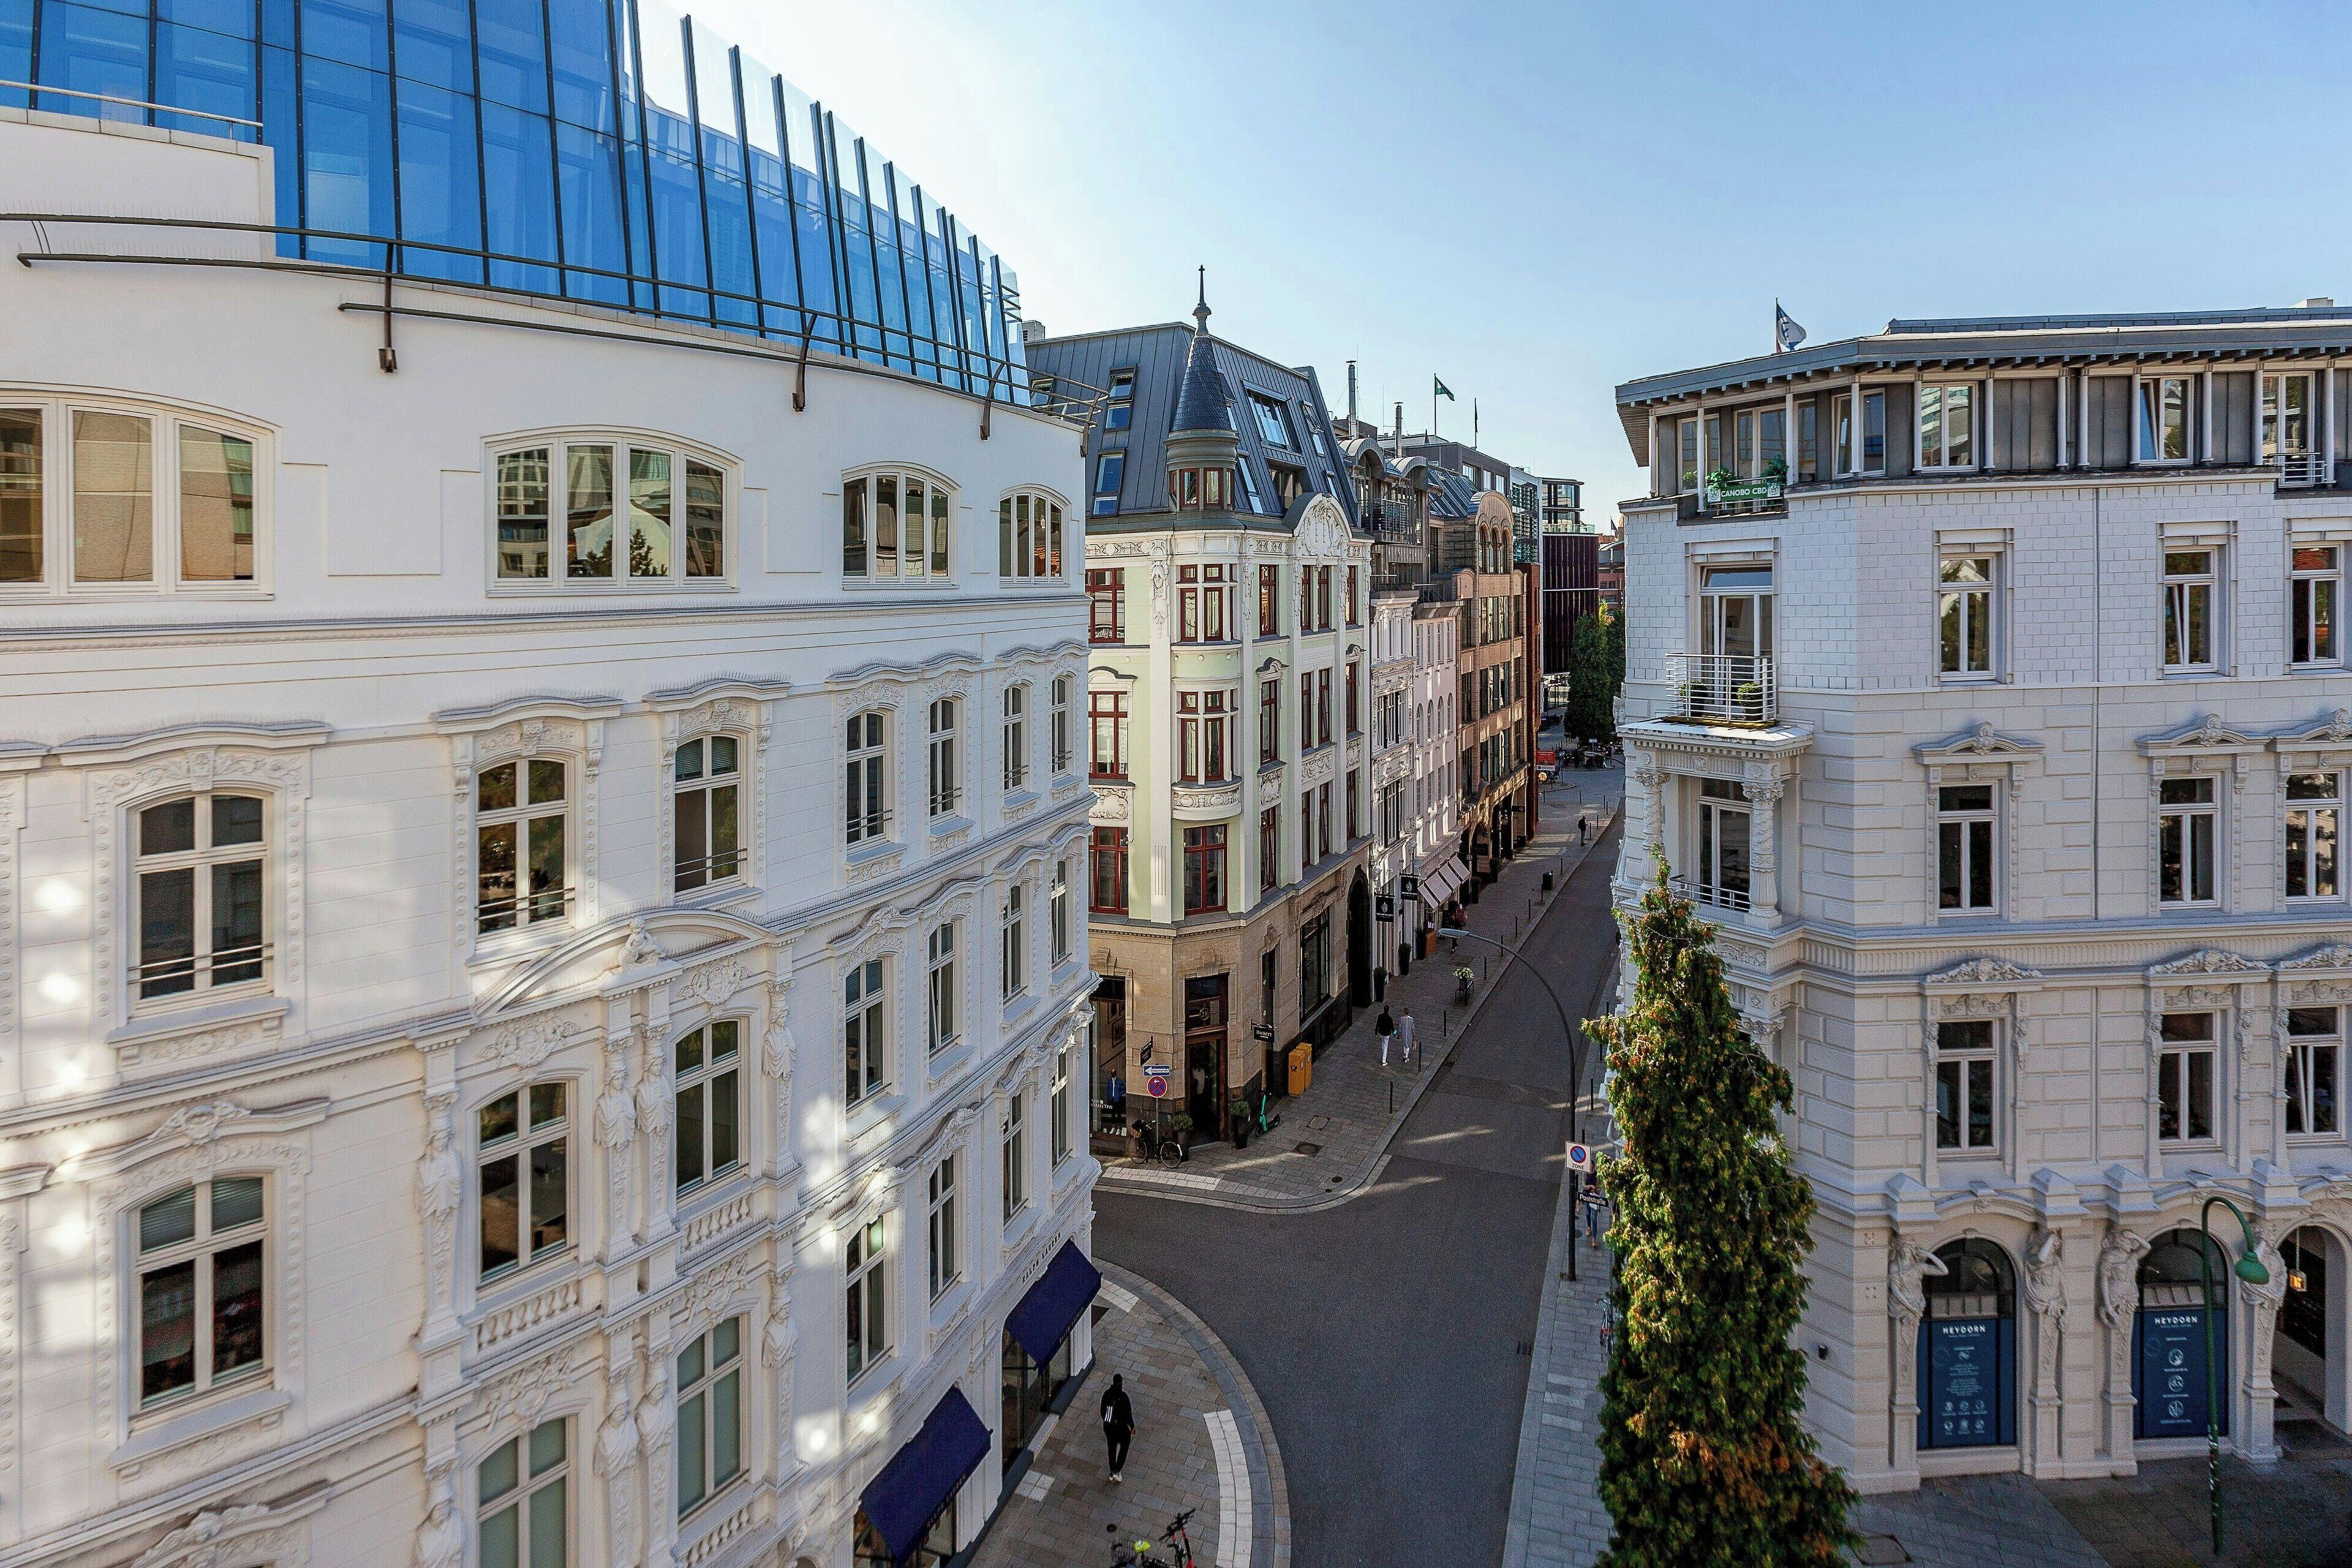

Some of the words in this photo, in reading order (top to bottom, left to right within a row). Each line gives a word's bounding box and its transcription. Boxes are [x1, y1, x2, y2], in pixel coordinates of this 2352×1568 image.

[1580, 1194, 1606, 1205] Poststraße
[1022, 1258, 1039, 1284] RALPH
[1042, 1231, 1061, 1260] LAUREN
[2155, 1316, 2198, 1324] HEYDORN
[1942, 1325, 1986, 1334] HEYDORN
